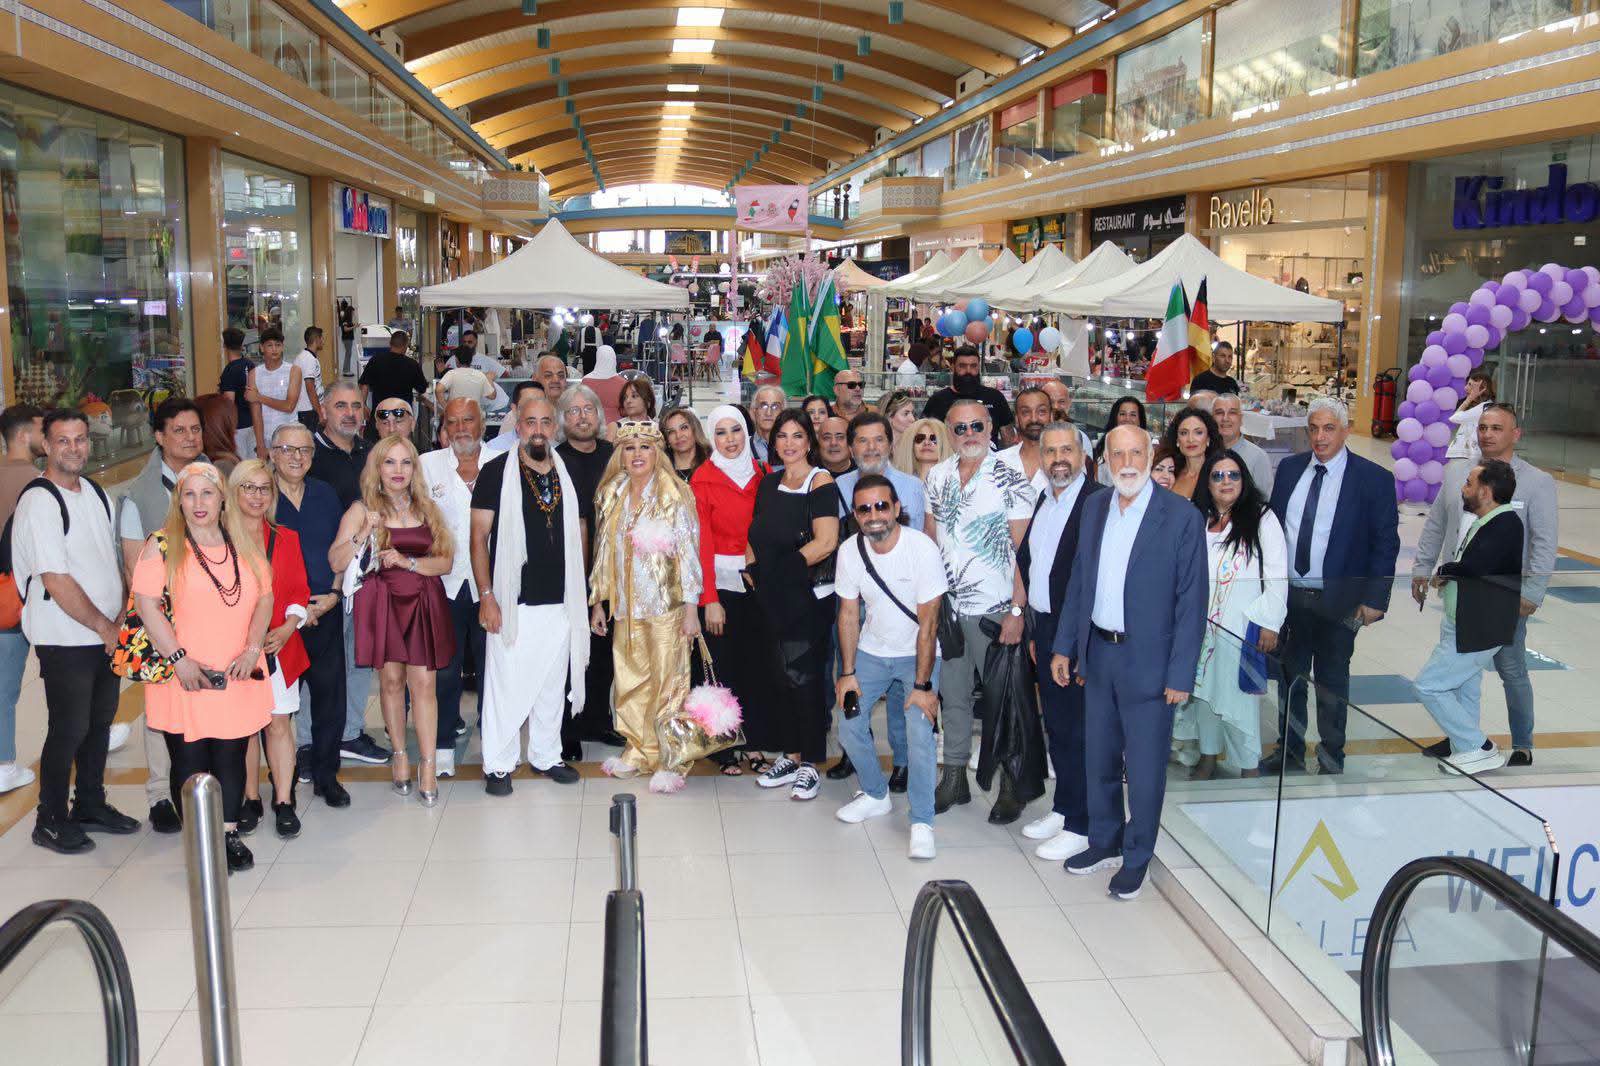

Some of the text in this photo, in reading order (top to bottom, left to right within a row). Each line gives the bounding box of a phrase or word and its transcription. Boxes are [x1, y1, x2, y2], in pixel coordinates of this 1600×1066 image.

[1209, 188, 1273, 229] Ravello
[1453, 163, 1600, 230] Kindo
[1094, 212, 1136, 232] RESTAURANT
